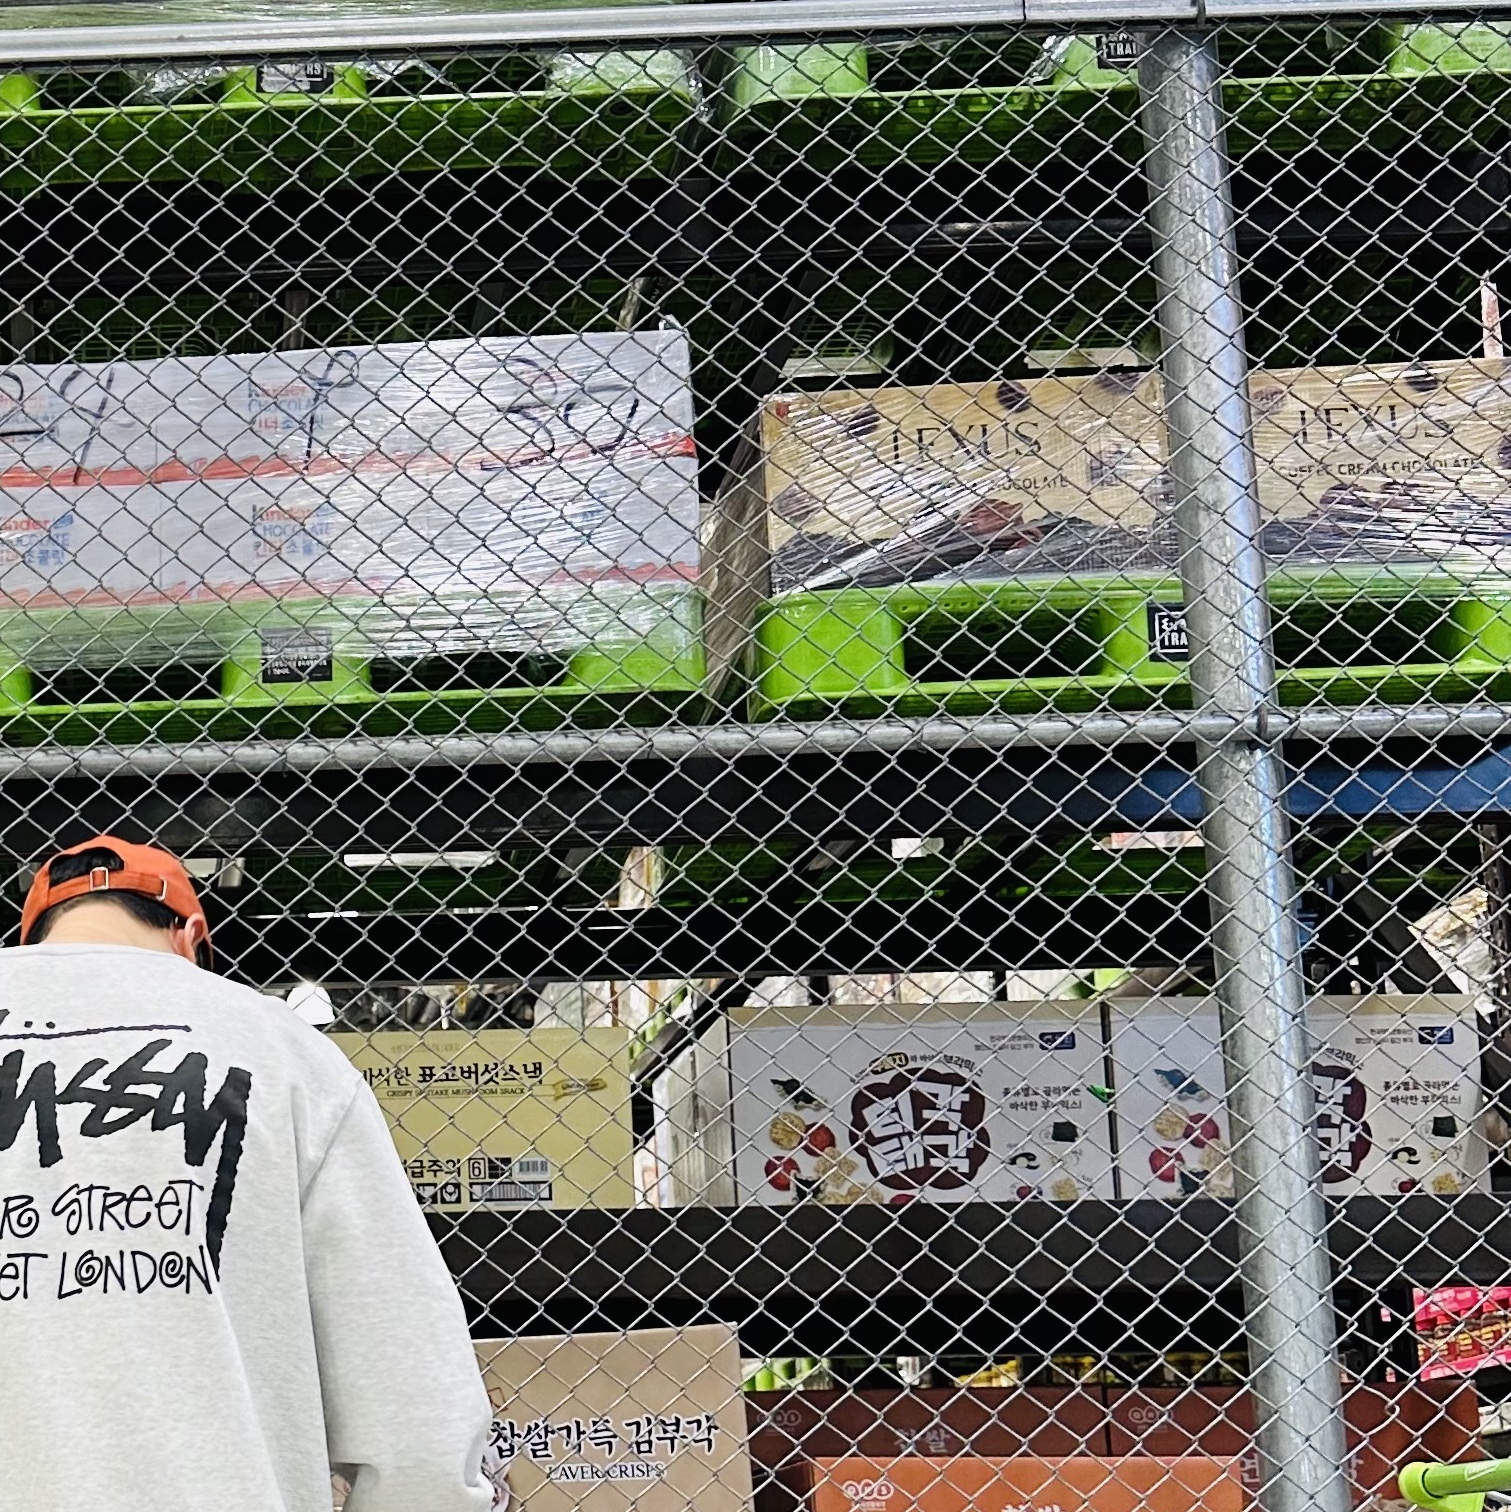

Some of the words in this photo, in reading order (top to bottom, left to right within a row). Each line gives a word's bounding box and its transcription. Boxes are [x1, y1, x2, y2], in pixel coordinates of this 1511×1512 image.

[402, 1158, 462, 1178] 급주의
[470, 1160, 484, 1179] 6
[57, 1244, 214, 1300] LONDON
[487, 1417, 620, 1460] 찹쌀가득
[625, 1411, 720, 1455] 김부각
[608, 1463, 666, 1479] CRISPS
